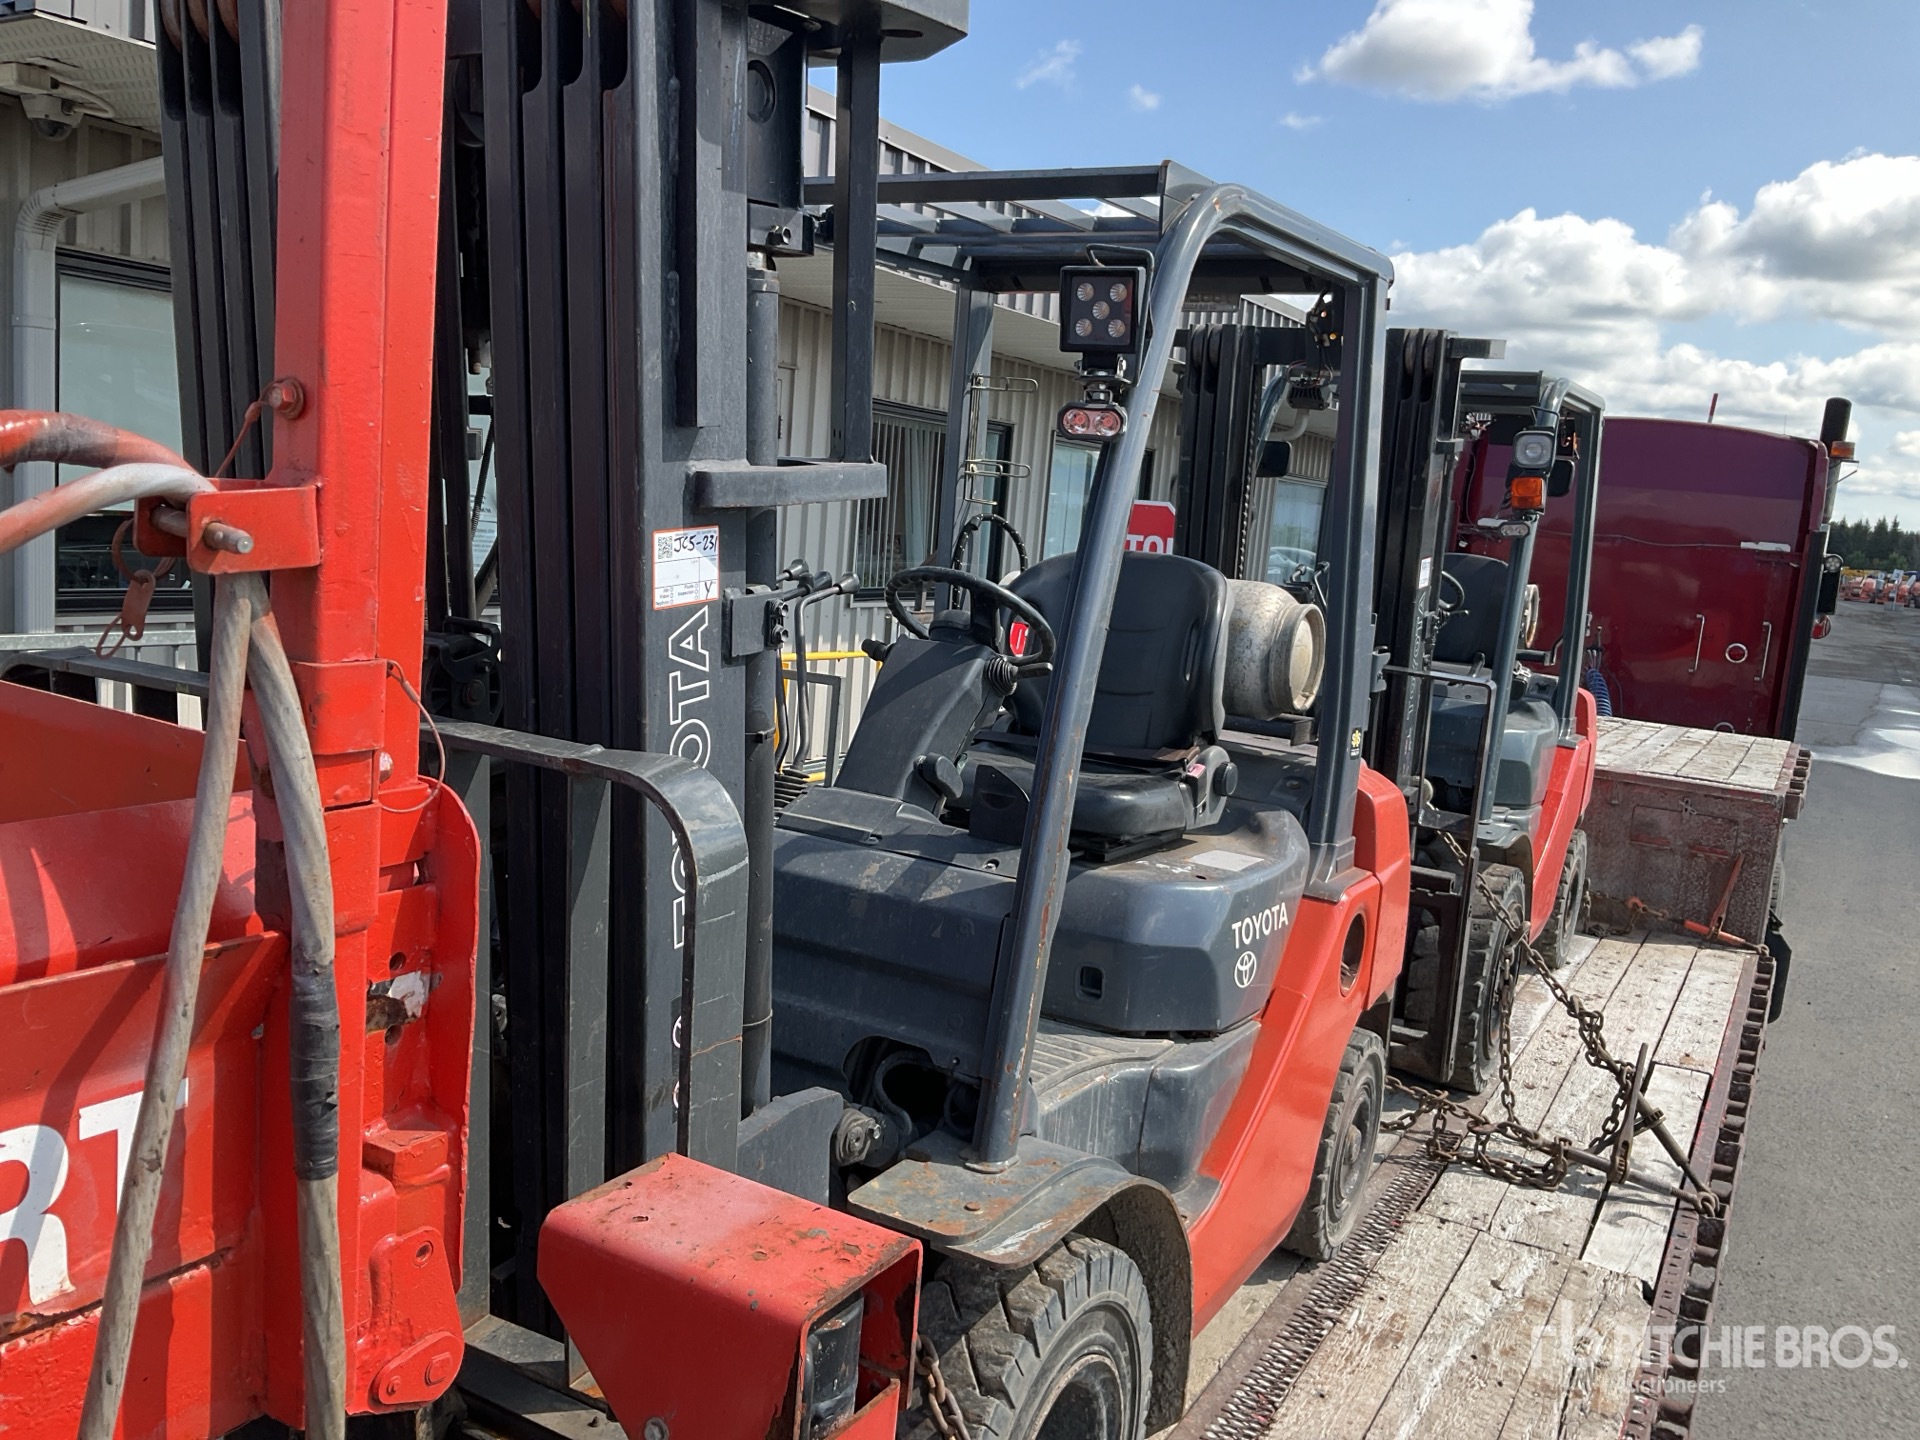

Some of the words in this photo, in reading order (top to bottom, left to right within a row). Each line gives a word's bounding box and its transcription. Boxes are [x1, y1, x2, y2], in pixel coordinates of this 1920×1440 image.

[1126, 534, 1174, 555] TO
[668, 604, 712, 949] TOTA
[1231, 902, 1289, 949] TOYOTA
